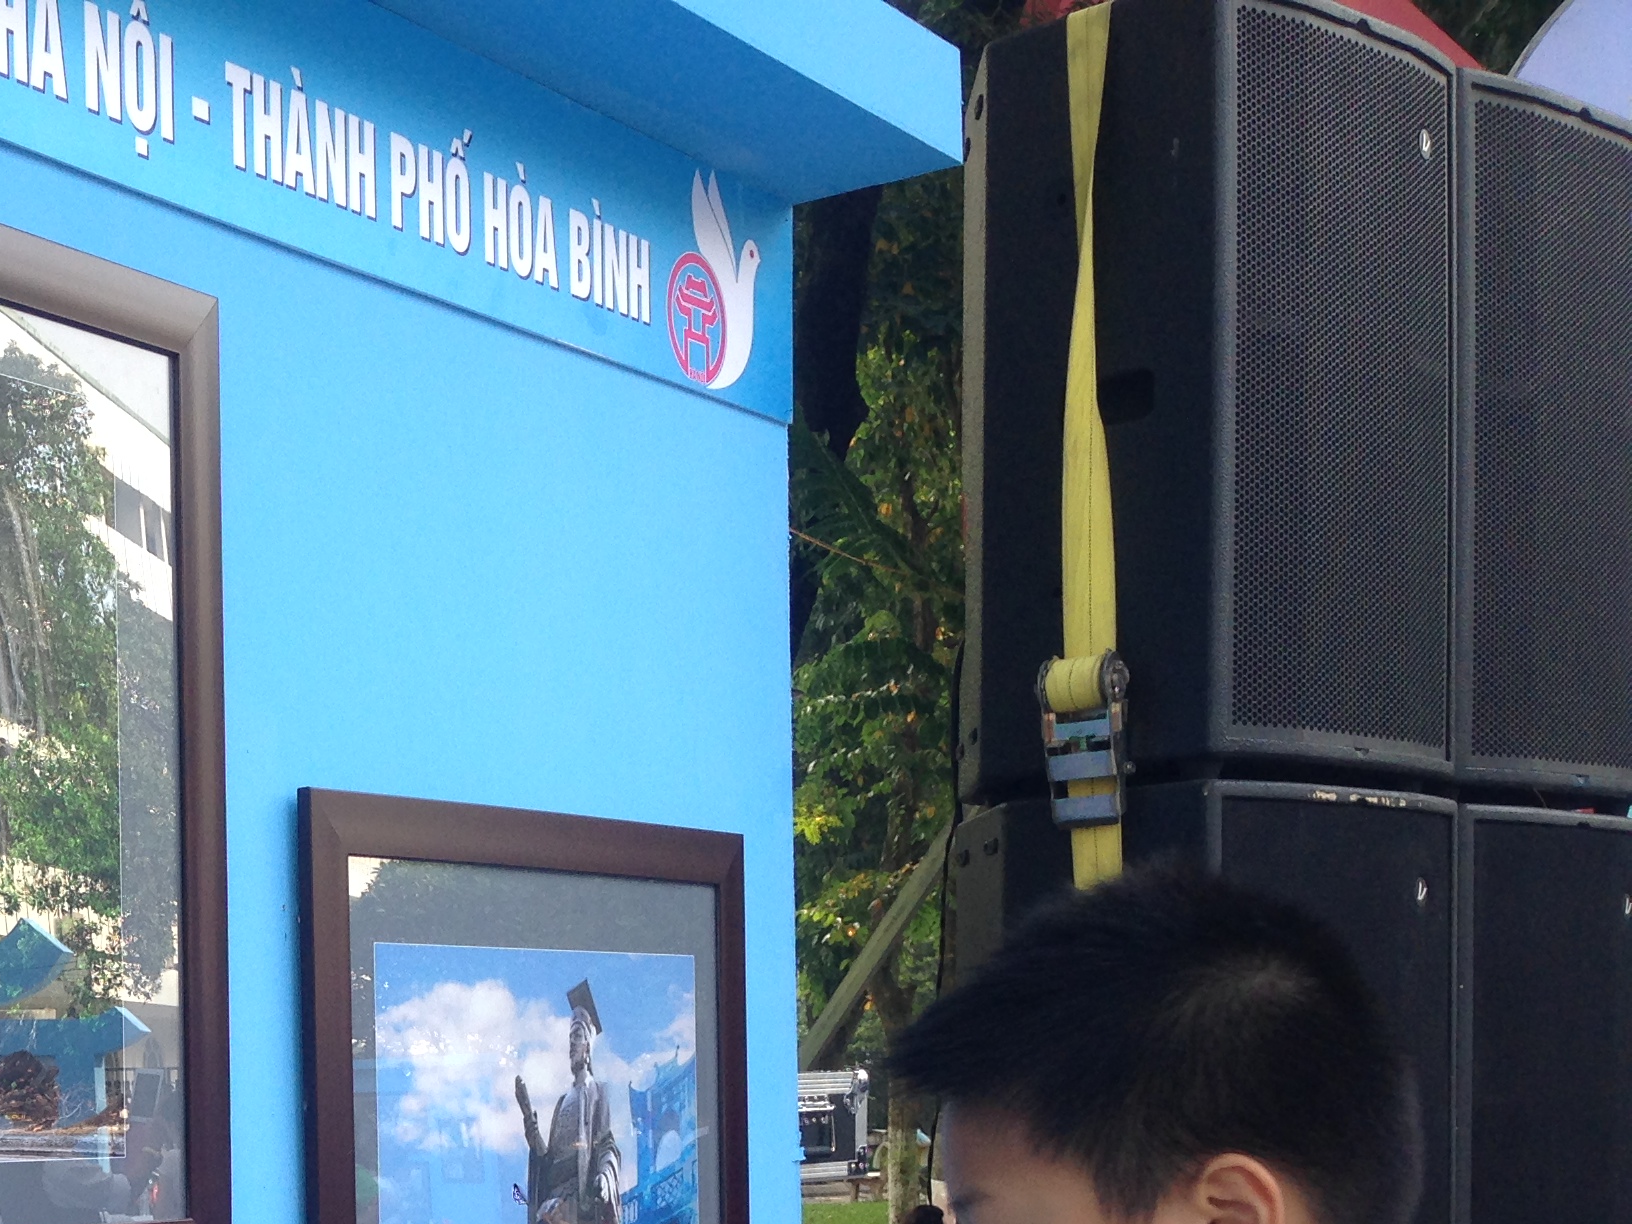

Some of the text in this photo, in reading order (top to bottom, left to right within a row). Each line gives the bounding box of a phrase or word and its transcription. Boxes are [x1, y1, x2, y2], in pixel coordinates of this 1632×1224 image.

[84, 0, 175, 160] NỘI
[192, 96, 211, 125] -
[225, 61, 377, 222] THÀNH
[390, 128, 472, 256] PHỐ
[483, 161, 559, 291] HÒA
[570, 198, 651, 326] BÌNH
